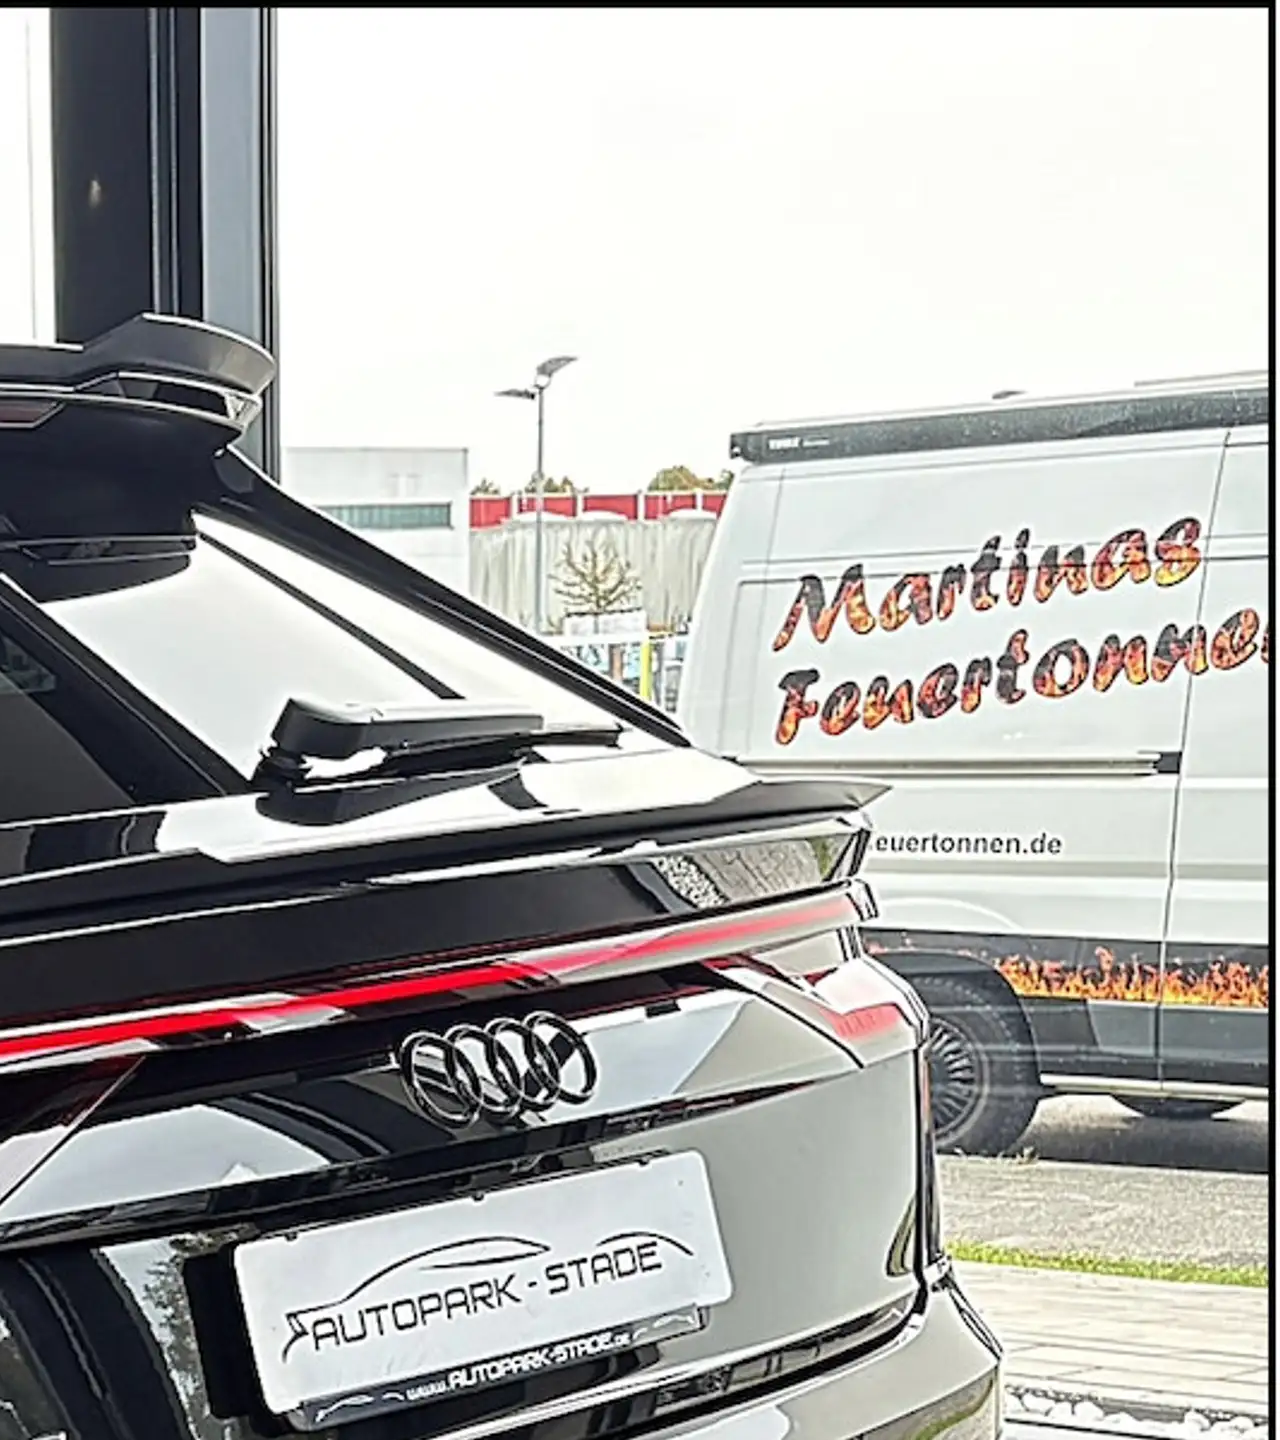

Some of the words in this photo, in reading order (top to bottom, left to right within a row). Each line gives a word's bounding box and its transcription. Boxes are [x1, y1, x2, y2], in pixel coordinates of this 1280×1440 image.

[772, 517, 1202, 653] Martinas
[873, 831, 1064, 855] euertonnen.de
[313, 1273, 520, 1351] AUTOPARK
[547, 1242, 663, 1297] STADE
